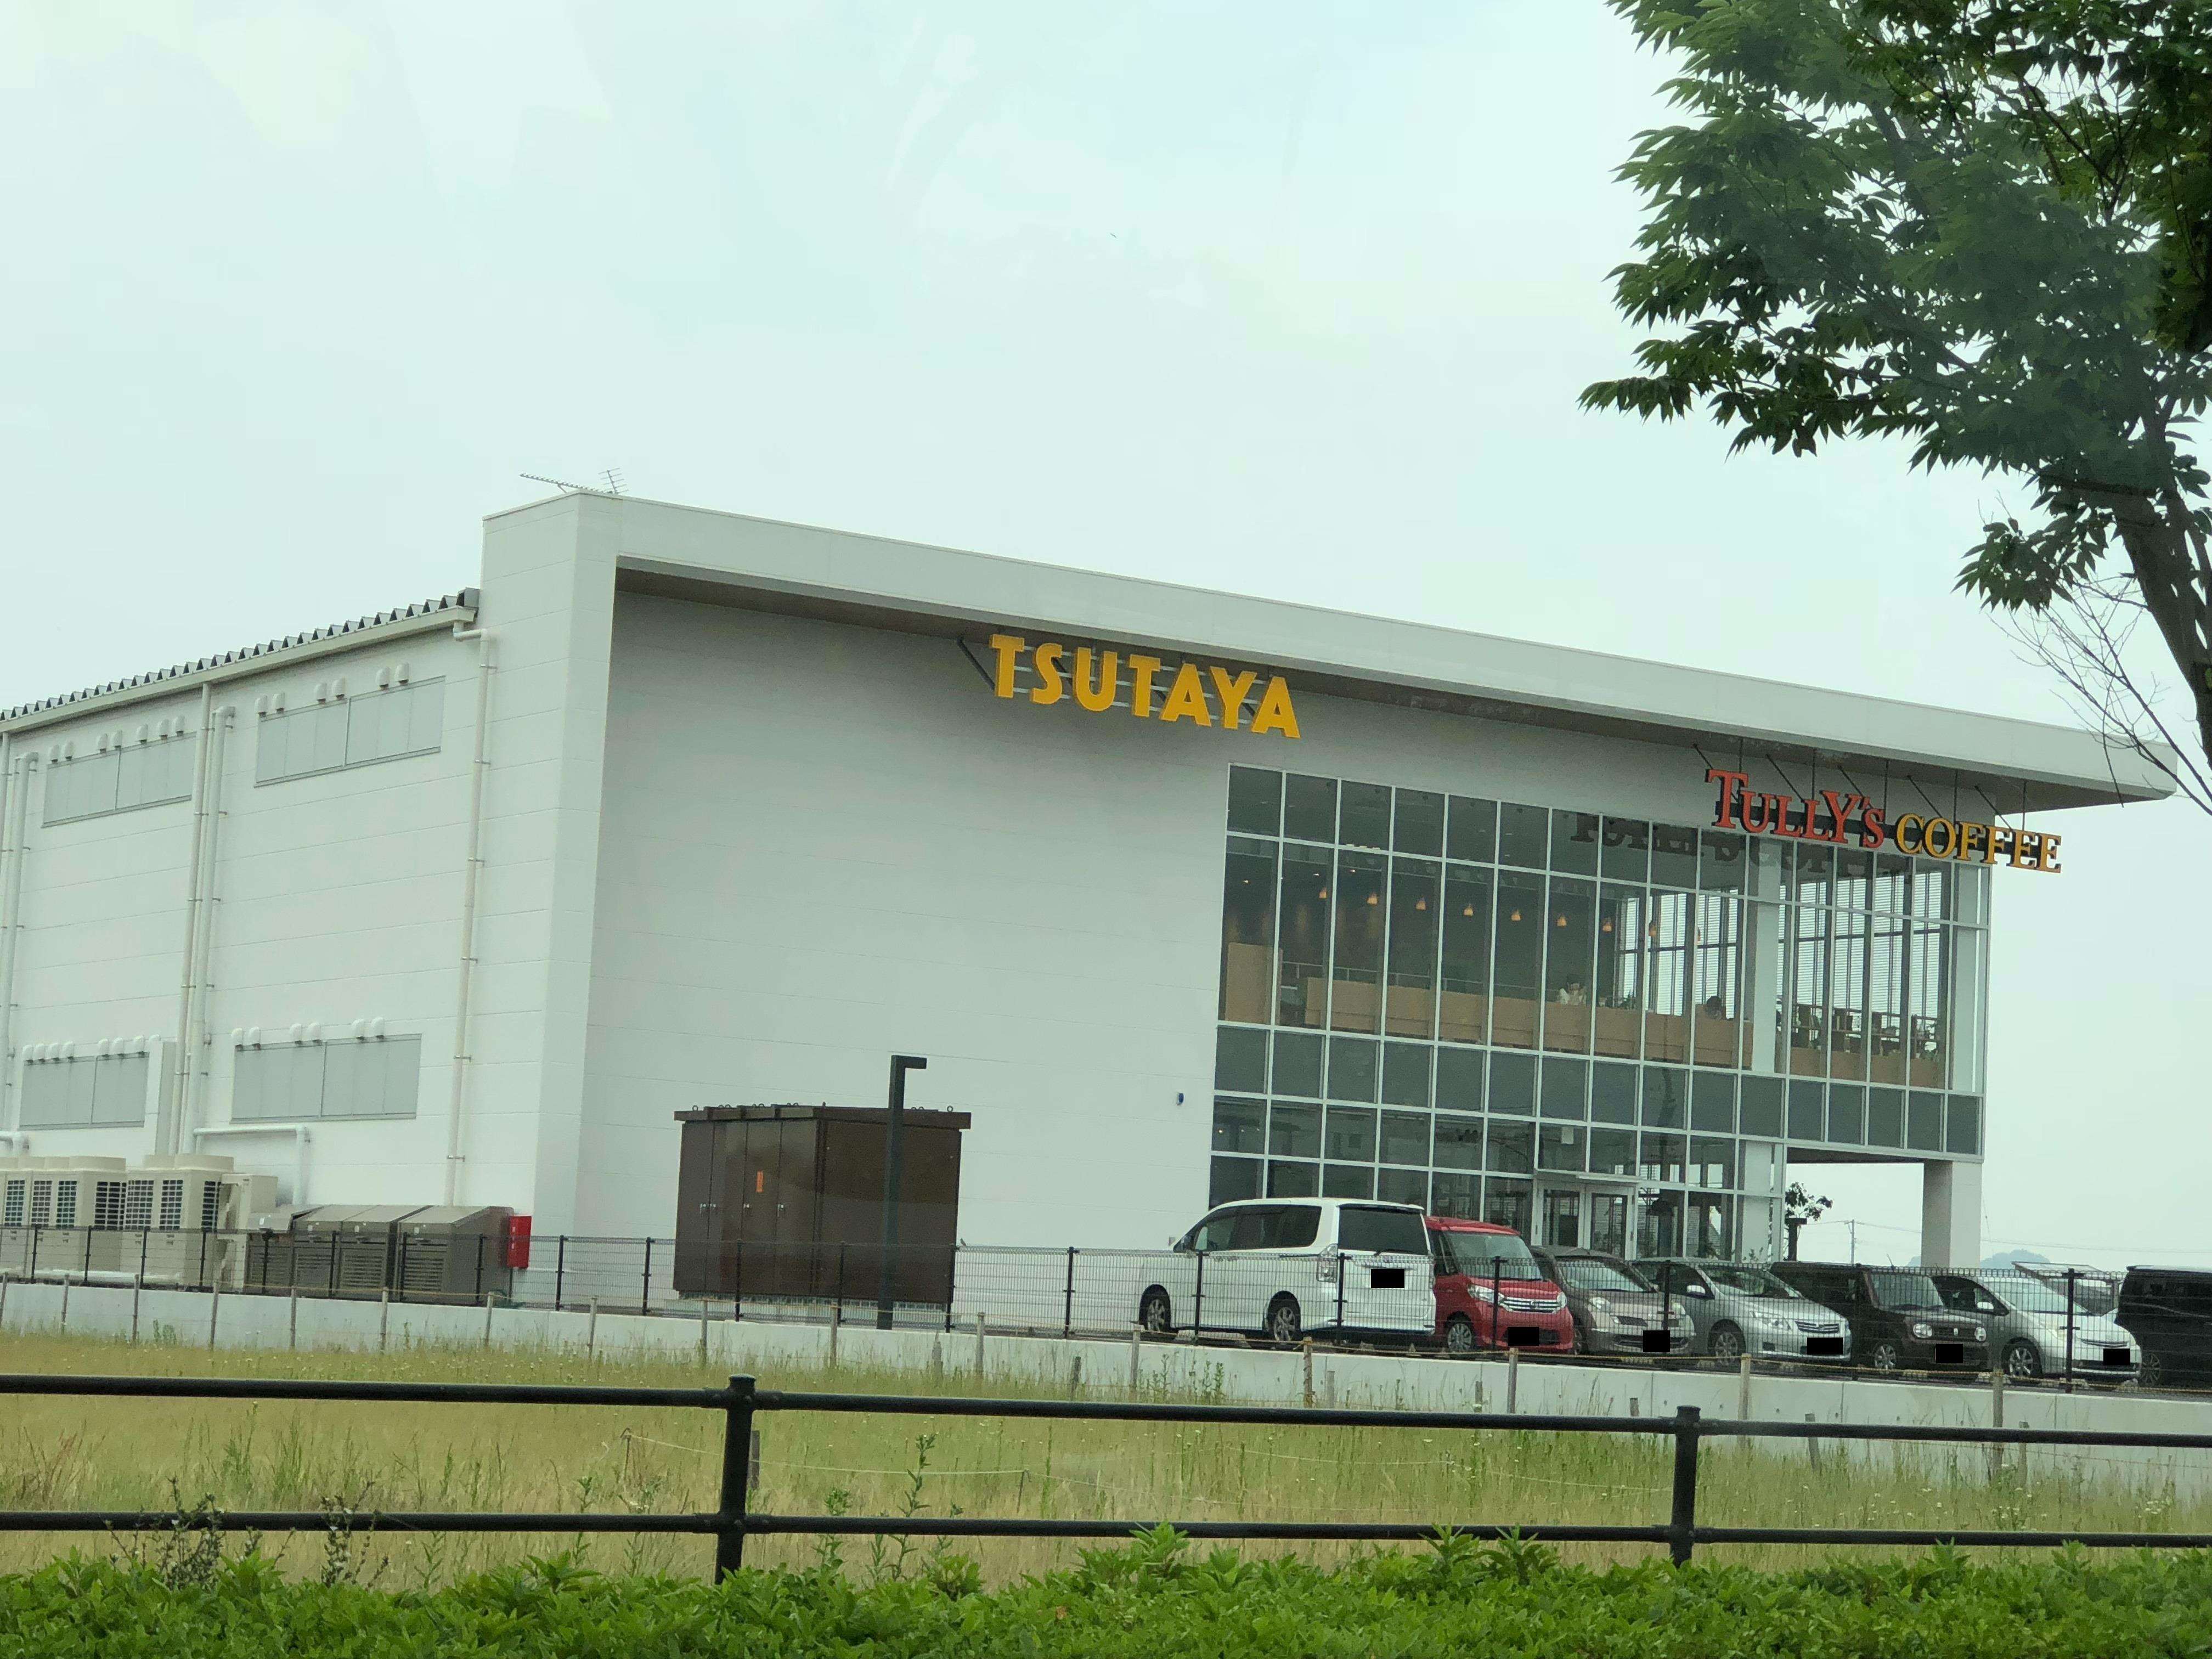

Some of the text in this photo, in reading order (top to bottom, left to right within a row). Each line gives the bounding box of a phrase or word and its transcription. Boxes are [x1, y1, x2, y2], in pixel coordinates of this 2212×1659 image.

[991, 634, 1301, 738] TSUTAYA
[1705, 768, 1886, 848] TULLY'S
[1894, 812, 2062, 873] COFFEE
